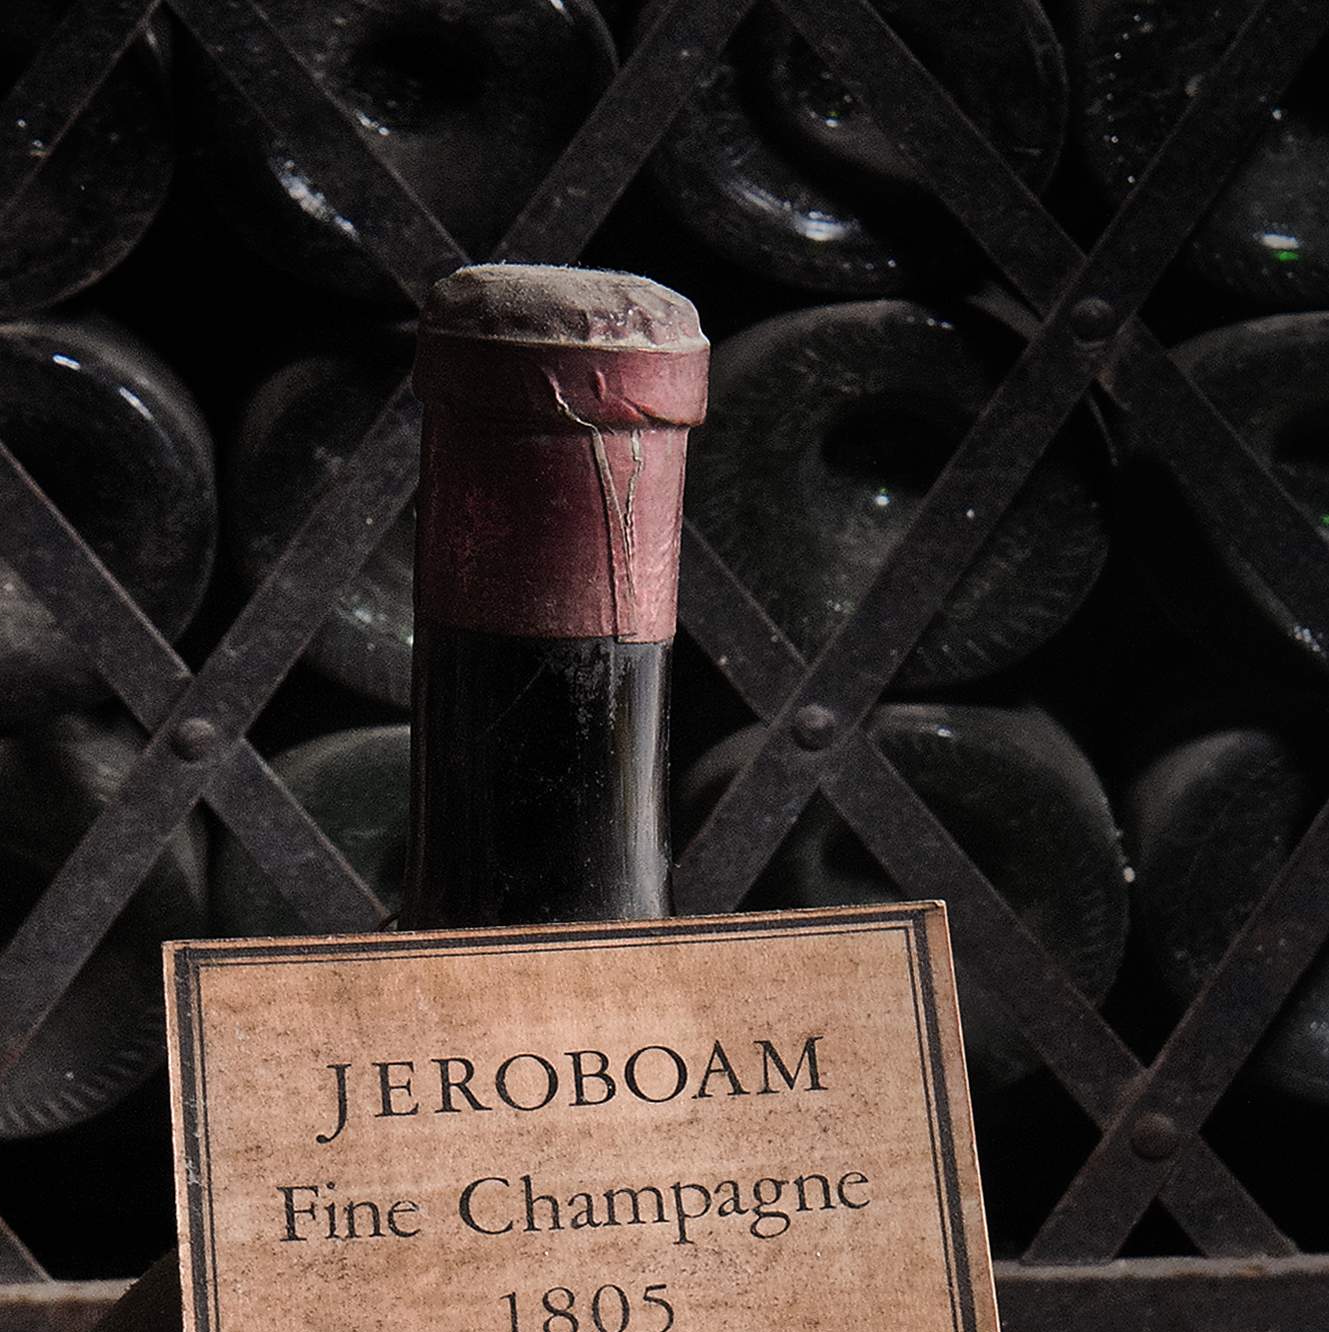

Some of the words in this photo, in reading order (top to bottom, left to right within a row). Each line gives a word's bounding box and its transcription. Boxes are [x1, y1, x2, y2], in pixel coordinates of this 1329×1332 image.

[315, 1035, 829, 1144] JEROBOAM
[276, 1181, 421, 1242] Fine
[458, 1171, 870, 1246] Champagne
